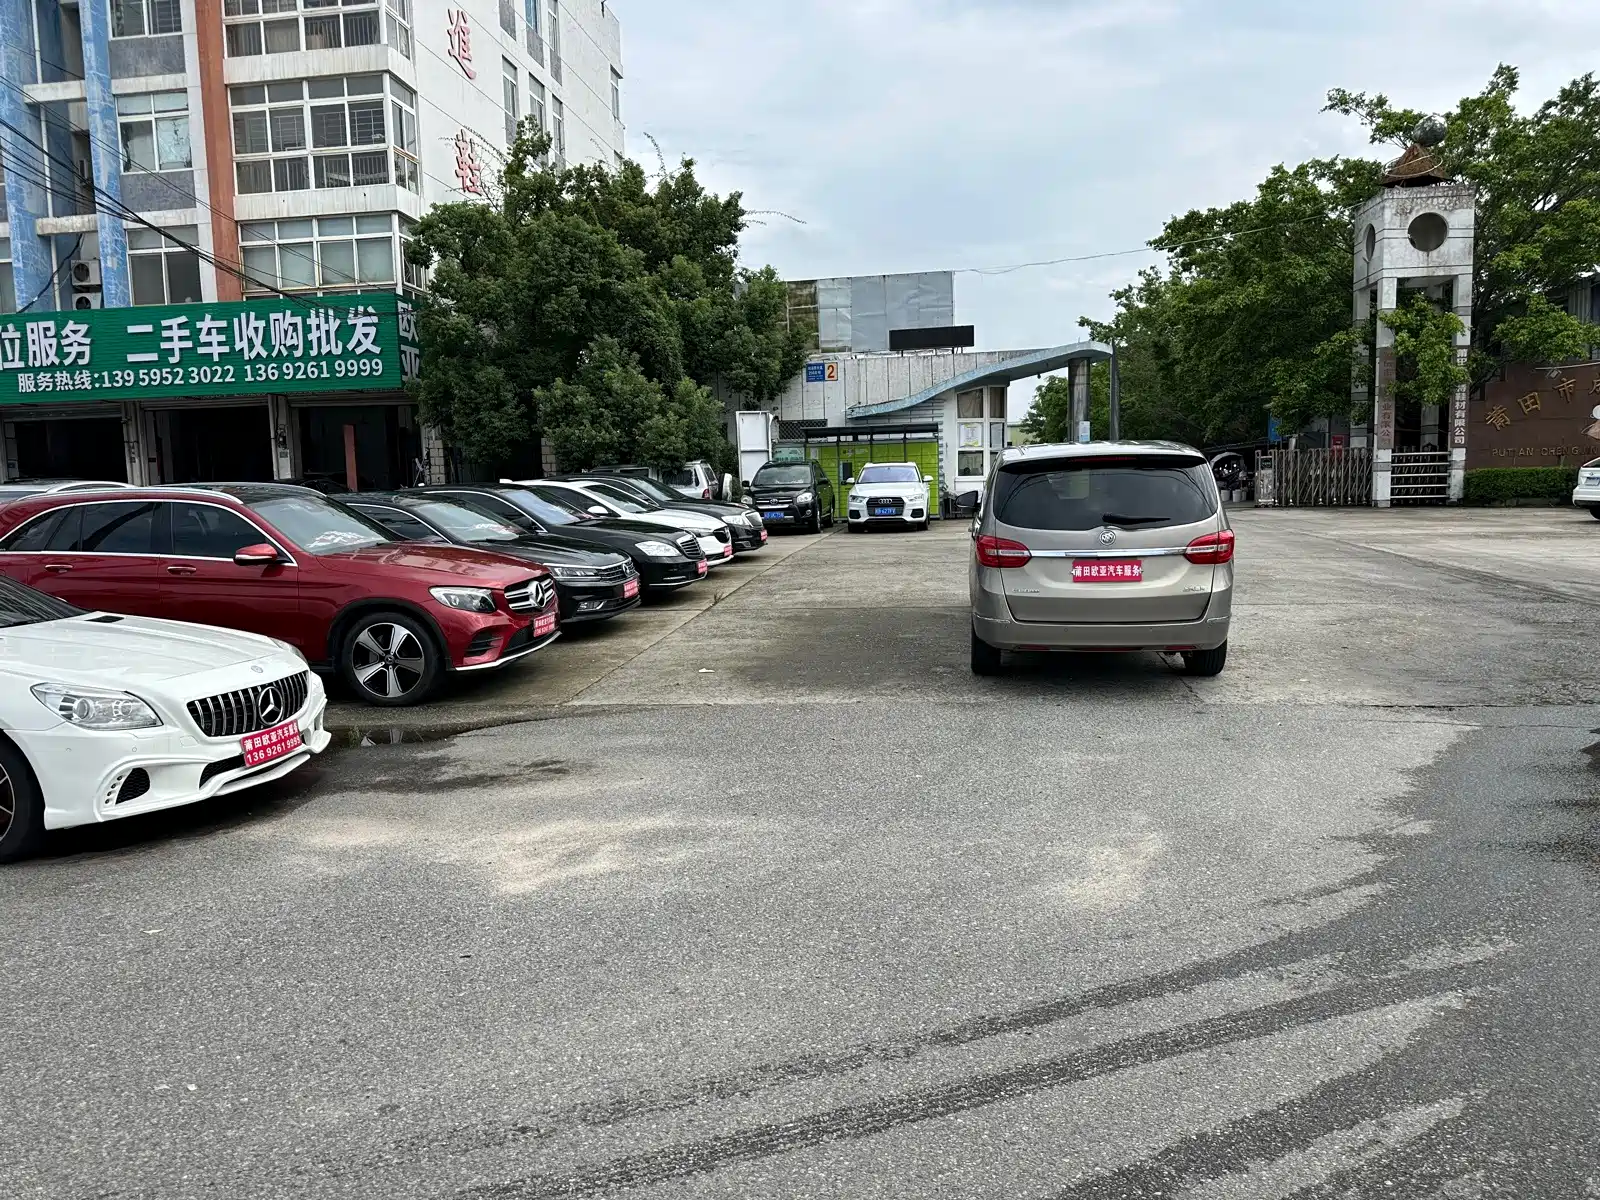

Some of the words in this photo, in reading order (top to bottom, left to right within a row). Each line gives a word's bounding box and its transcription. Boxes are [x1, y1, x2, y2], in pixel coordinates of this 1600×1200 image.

[127, 305, 381, 364] 二手车收购批发
[139, 367, 185, 386] 5952
[188, 365, 235, 384] 3022
[244, 363, 279, 382] 136
[282, 360, 331, 380] 9261
[334, 358, 383, 378] 9999
[827, 364, 835, 379] 2
[1074, 564, 1140, 577] 莆田欧亚汽车服务
[247, 749, 265, 763] 136
[266, 742, 286, 757] 9261
